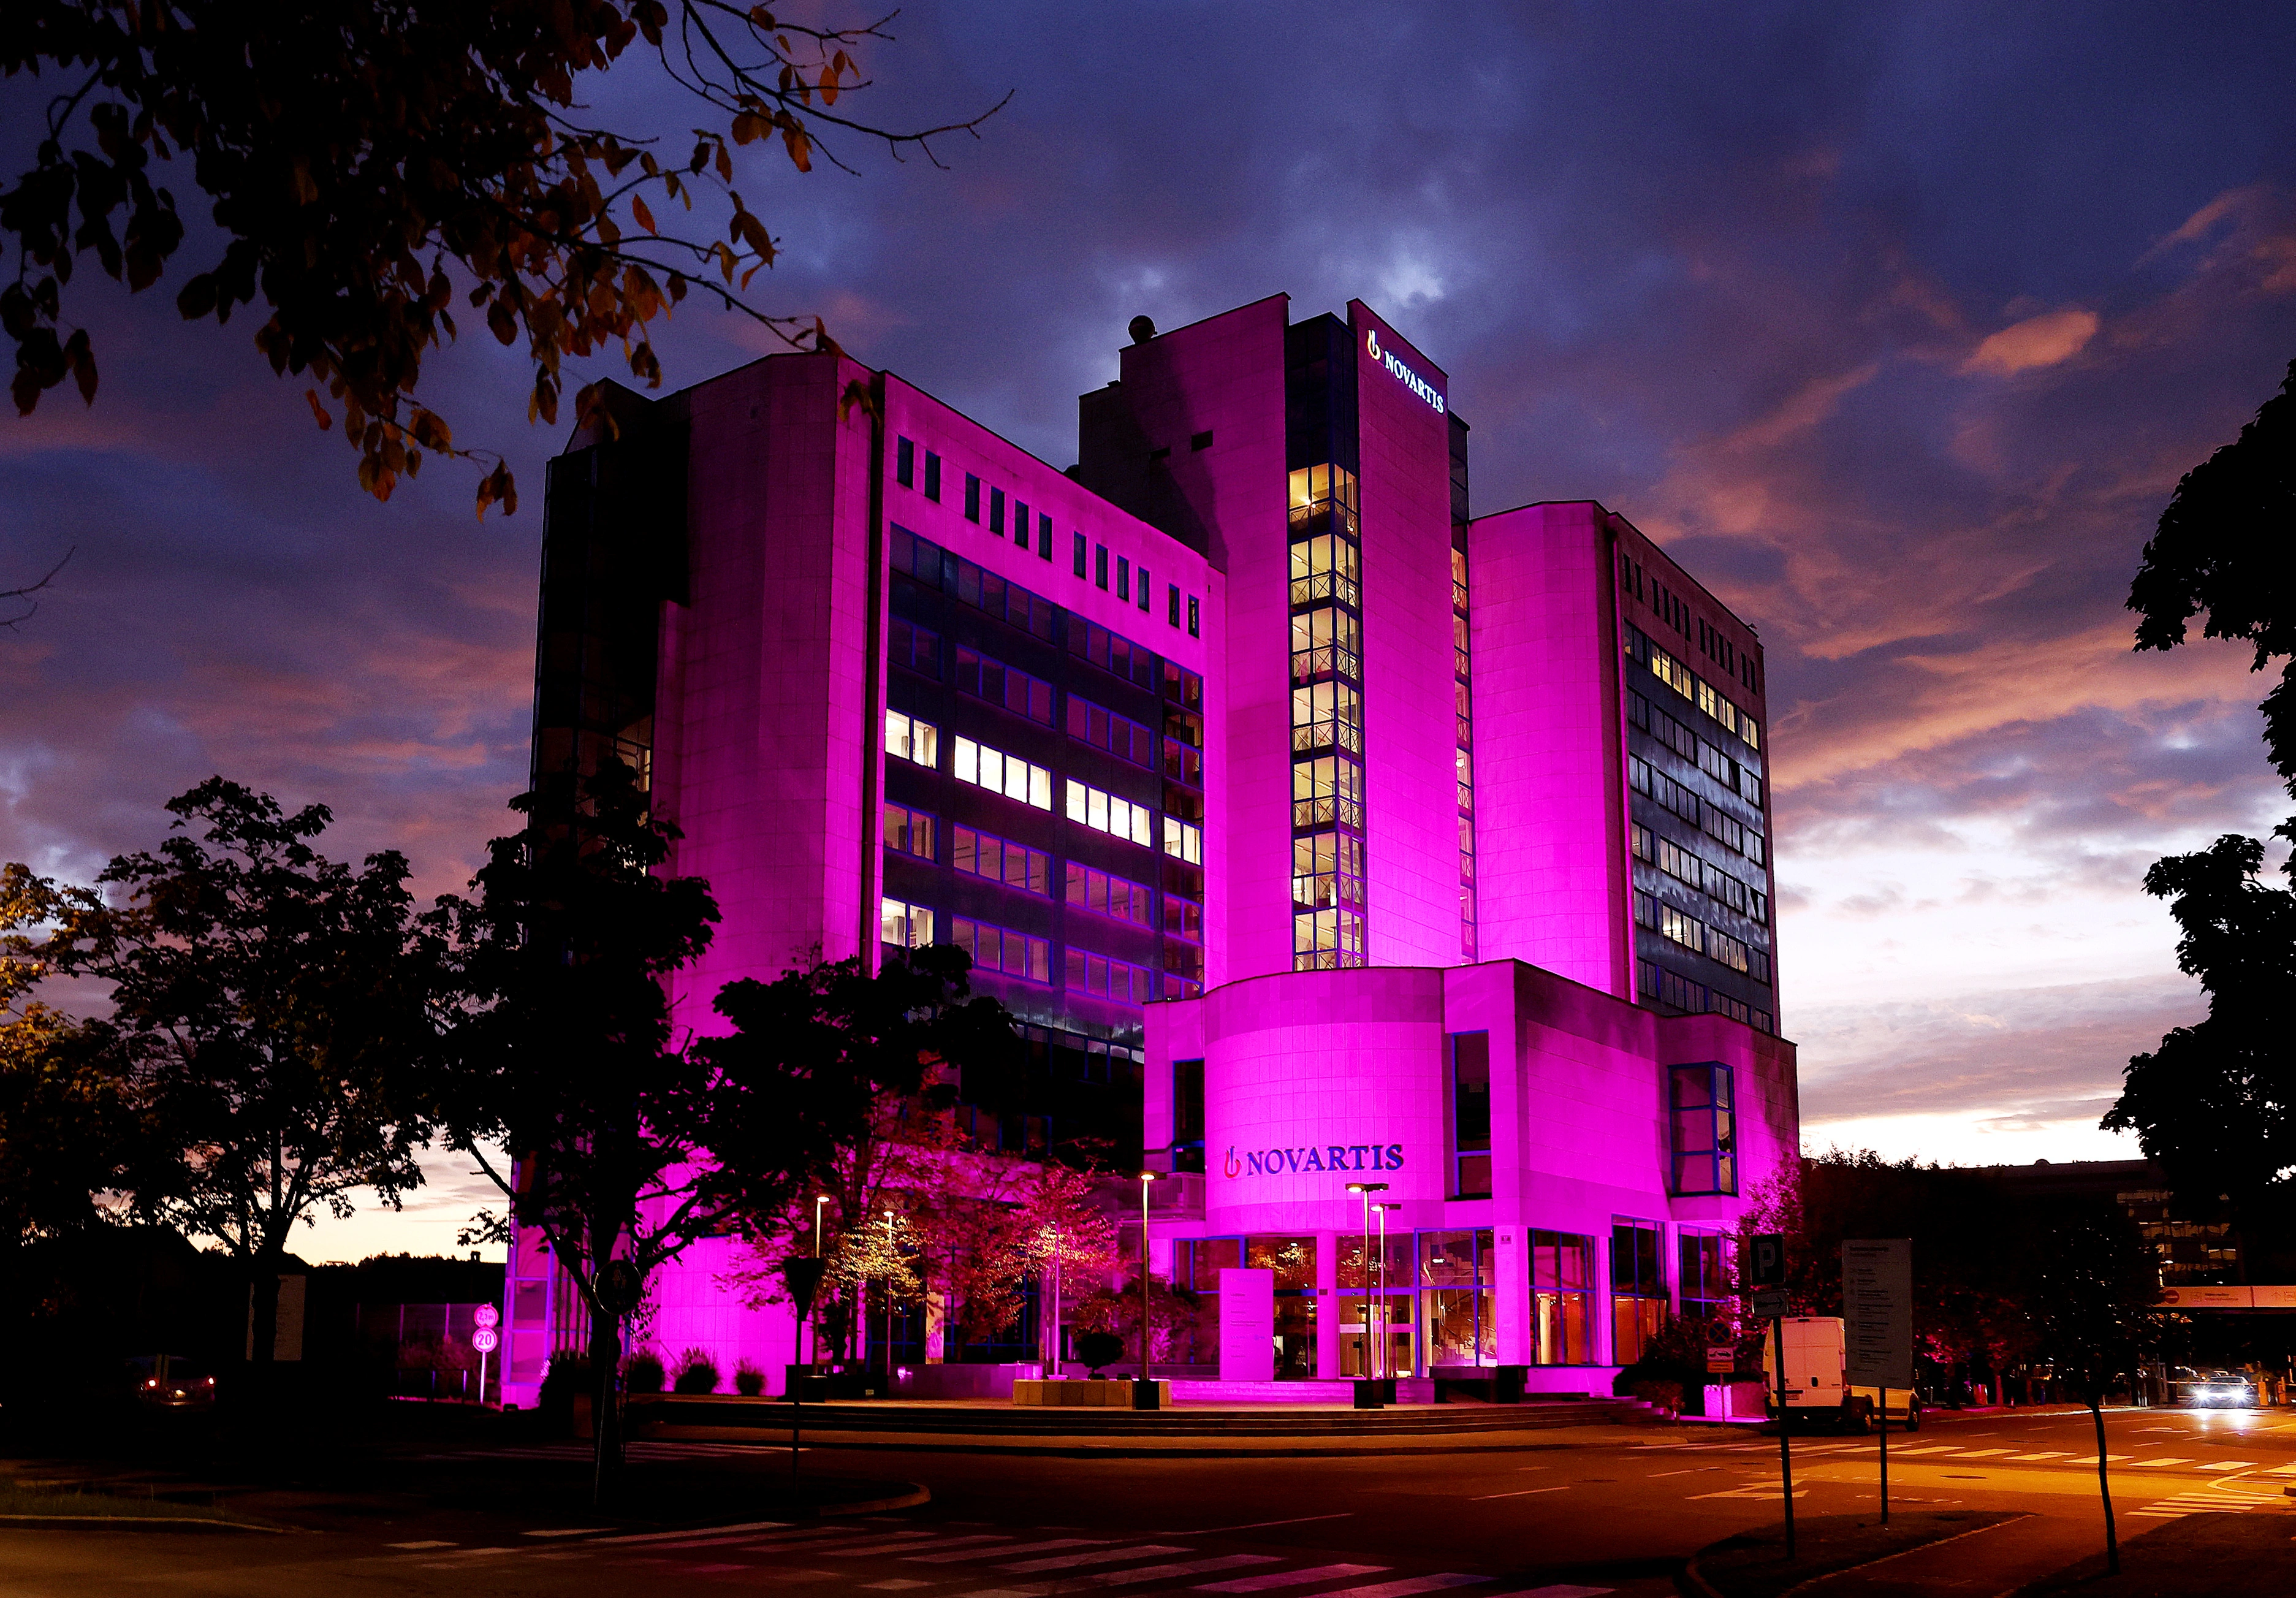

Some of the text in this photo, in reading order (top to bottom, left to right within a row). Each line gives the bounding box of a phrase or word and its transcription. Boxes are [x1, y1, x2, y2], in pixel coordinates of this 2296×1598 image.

[1385, 351, 1444, 414] NOVARTIS
[1247, 1144, 1404, 1176] NOVARTIS
[1757, 1242, 1776, 1277] P
[477, 1333, 492, 1345] 20
